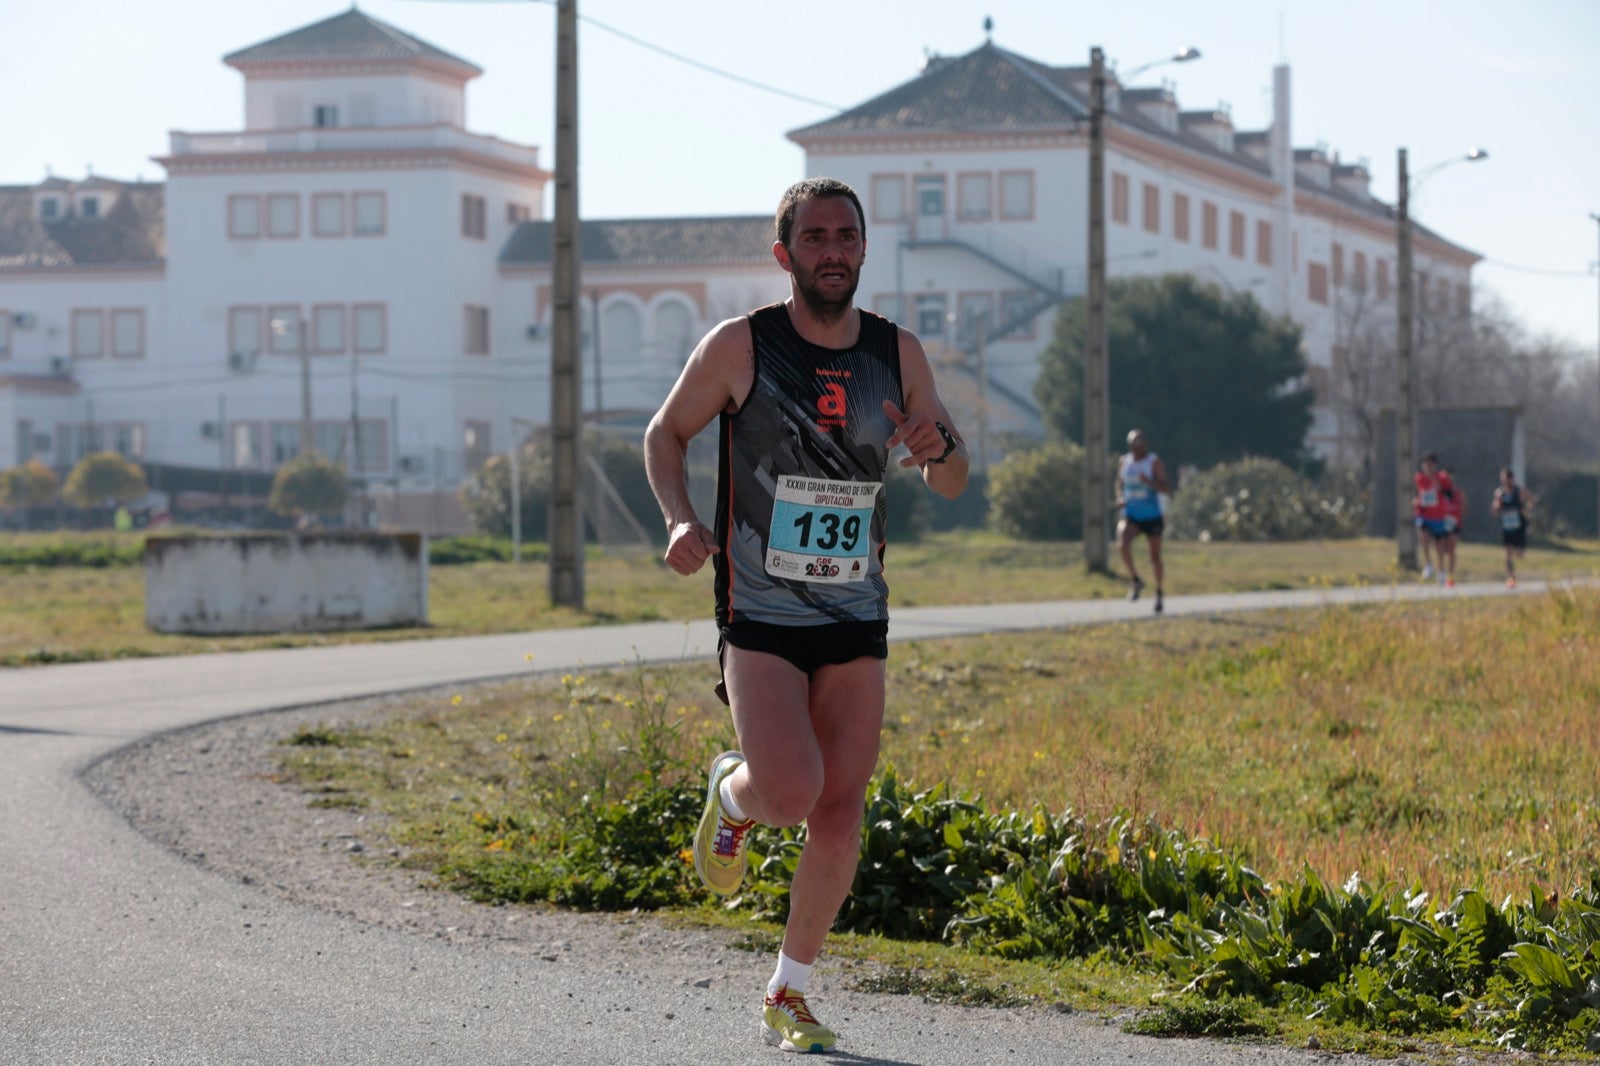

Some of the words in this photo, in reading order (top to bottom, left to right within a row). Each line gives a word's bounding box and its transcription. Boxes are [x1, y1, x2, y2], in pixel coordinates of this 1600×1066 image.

[785, 480, 806, 490] XXXIII
[807, 482, 826, 493] GRAN
[827, 484, 851, 495] PREMIO
[851, 486, 860, 496] DE
[794, 512, 861, 551] 139
